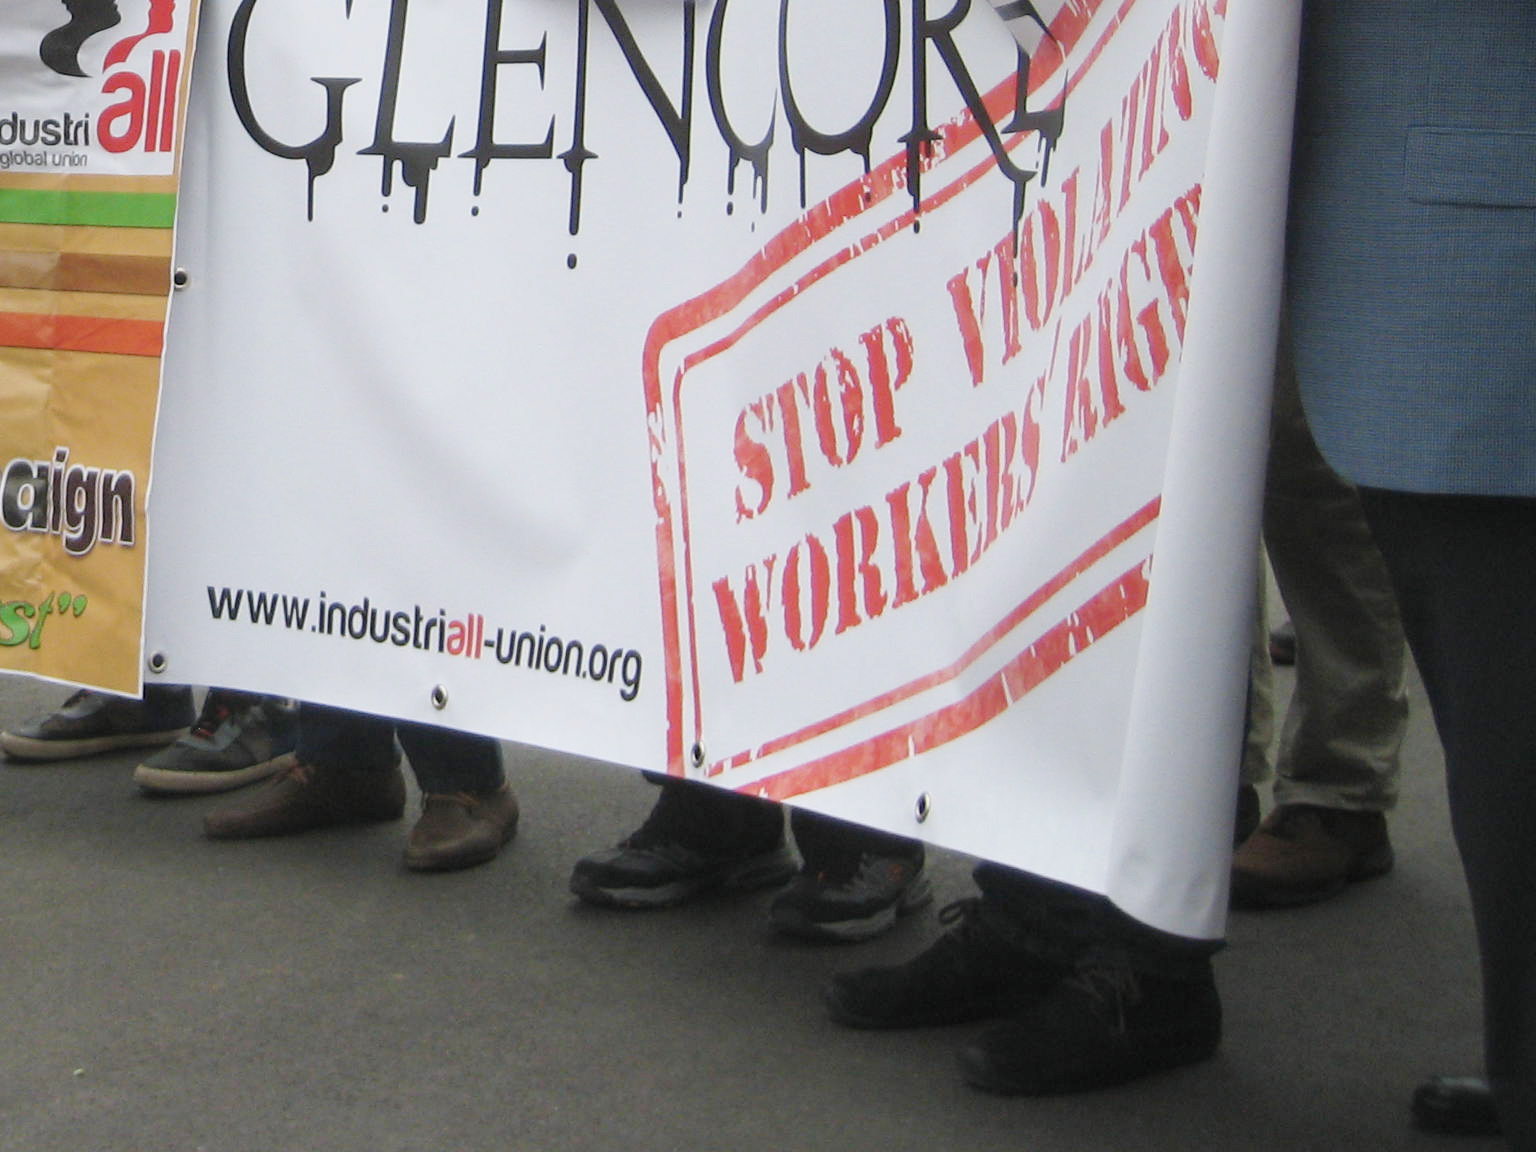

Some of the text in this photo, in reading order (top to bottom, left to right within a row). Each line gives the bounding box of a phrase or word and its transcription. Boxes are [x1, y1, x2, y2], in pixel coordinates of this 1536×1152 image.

[0, 150, 88, 169] global union
[733, 316, 916, 525] STOP
[206, 584, 643, 702] www.industriall-union.org
